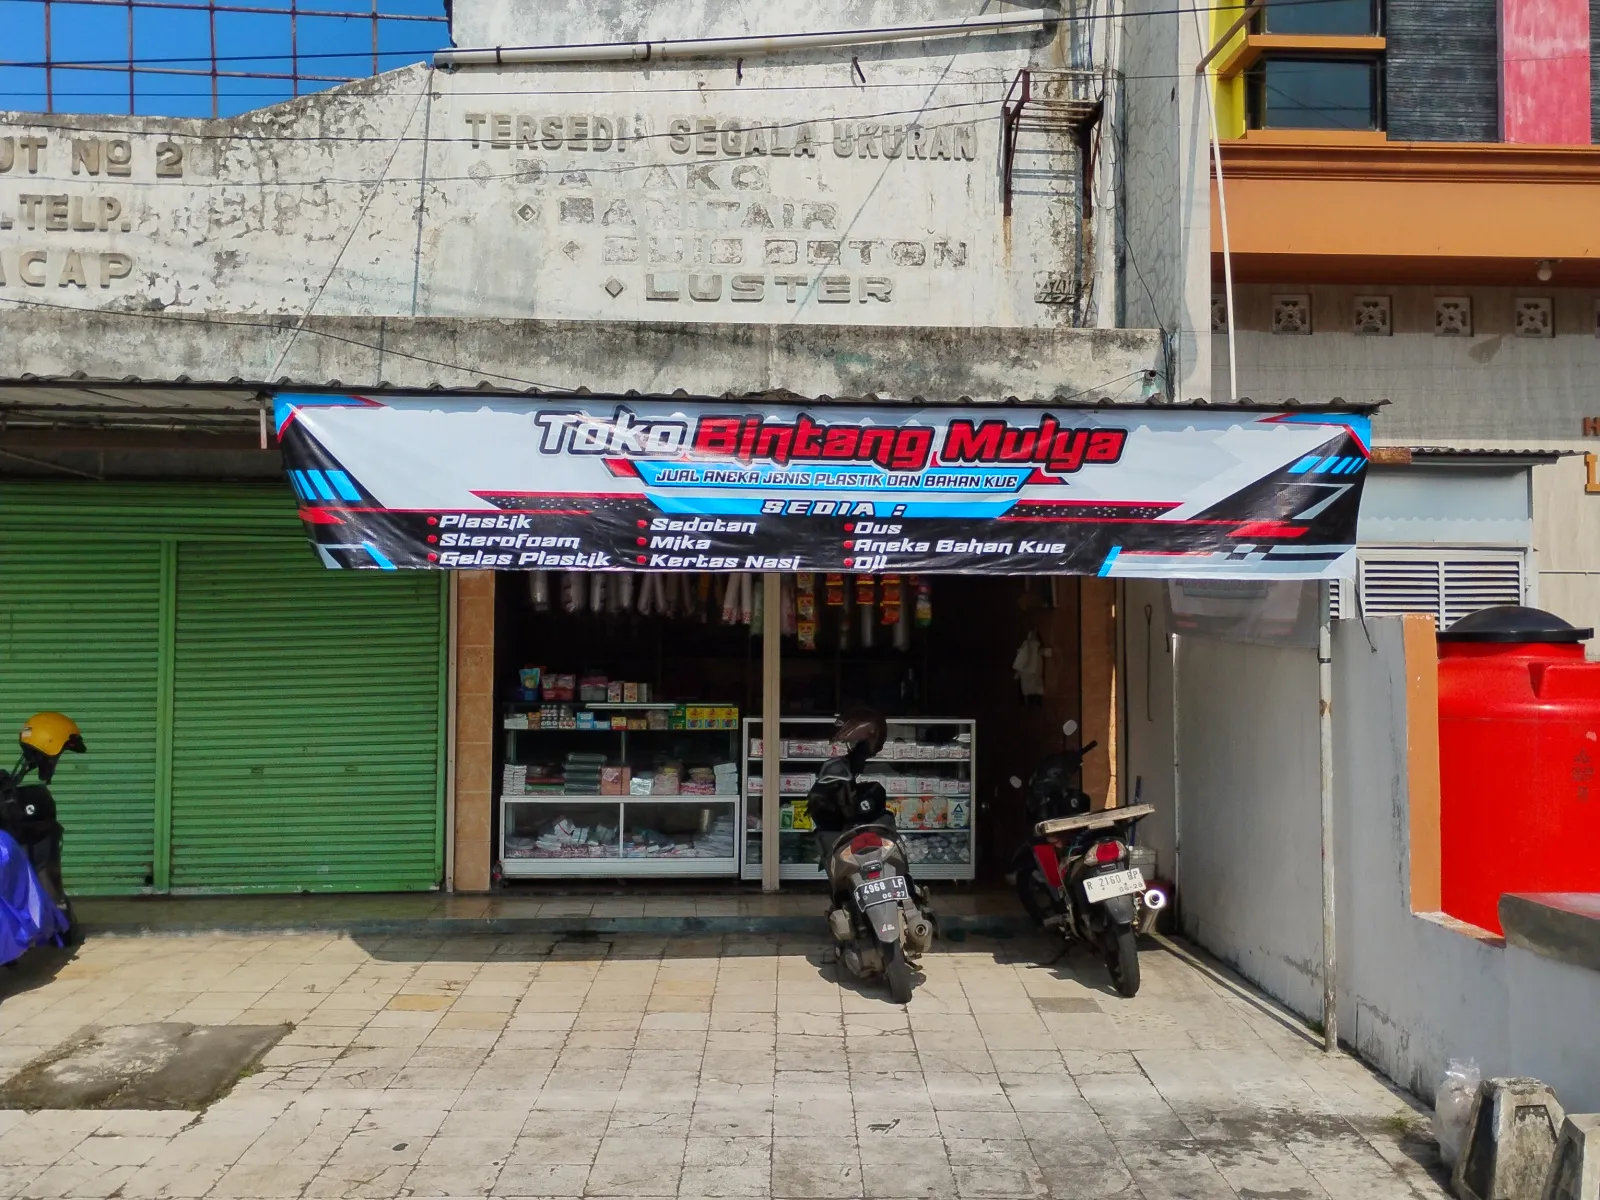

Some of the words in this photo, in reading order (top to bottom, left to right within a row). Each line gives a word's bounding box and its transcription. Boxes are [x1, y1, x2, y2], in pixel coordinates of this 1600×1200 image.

[669, 119, 815, 157] SEGALA
[833, 122, 976, 161] UKURAN
[19, 193, 131, 232] TELP.
[0, 251, 133, 288] CAP
[645, 273, 892, 304] LUSTER
[535, 404, 688, 455] Toko
[694, 411, 935, 471] Bintang
[940, 413, 1128, 473] Mulya
[656, 469, 699, 482] JUAL
[703, 470, 760, 484] ANEKA
[762, 471, 811, 485] JENIS
[814, 472, 883, 488] PLASTIK
[886, 474, 921, 488] DAN
[923, 474, 981, 488] BAHAN
[983, 474, 1019, 489] KUE
[761, 499, 875, 516] SEDIA
[439, 513, 533, 531] Plastik
[650, 517, 757, 534] Sedotan
[854, 521, 903, 535] Dus
[439, 532, 581, 549] Sterofoam
[650, 534, 712, 551] Mika
[853, 537, 931, 554] Aneka
[935, 538, 1013, 555] Bahan
[1018, 540, 1066, 554] Kue
[439, 550, 513, 567] Gelas
[518, 550, 612, 568] Plastik
[650, 554, 739, 568] Kertas
[744, 555, 801, 571] Nasi
[863, 881, 886, 895] 4968
[891, 878, 903, 889] LF
[1086, 881, 1094, 891] R
[1100, 874, 1122, 888] 2160
